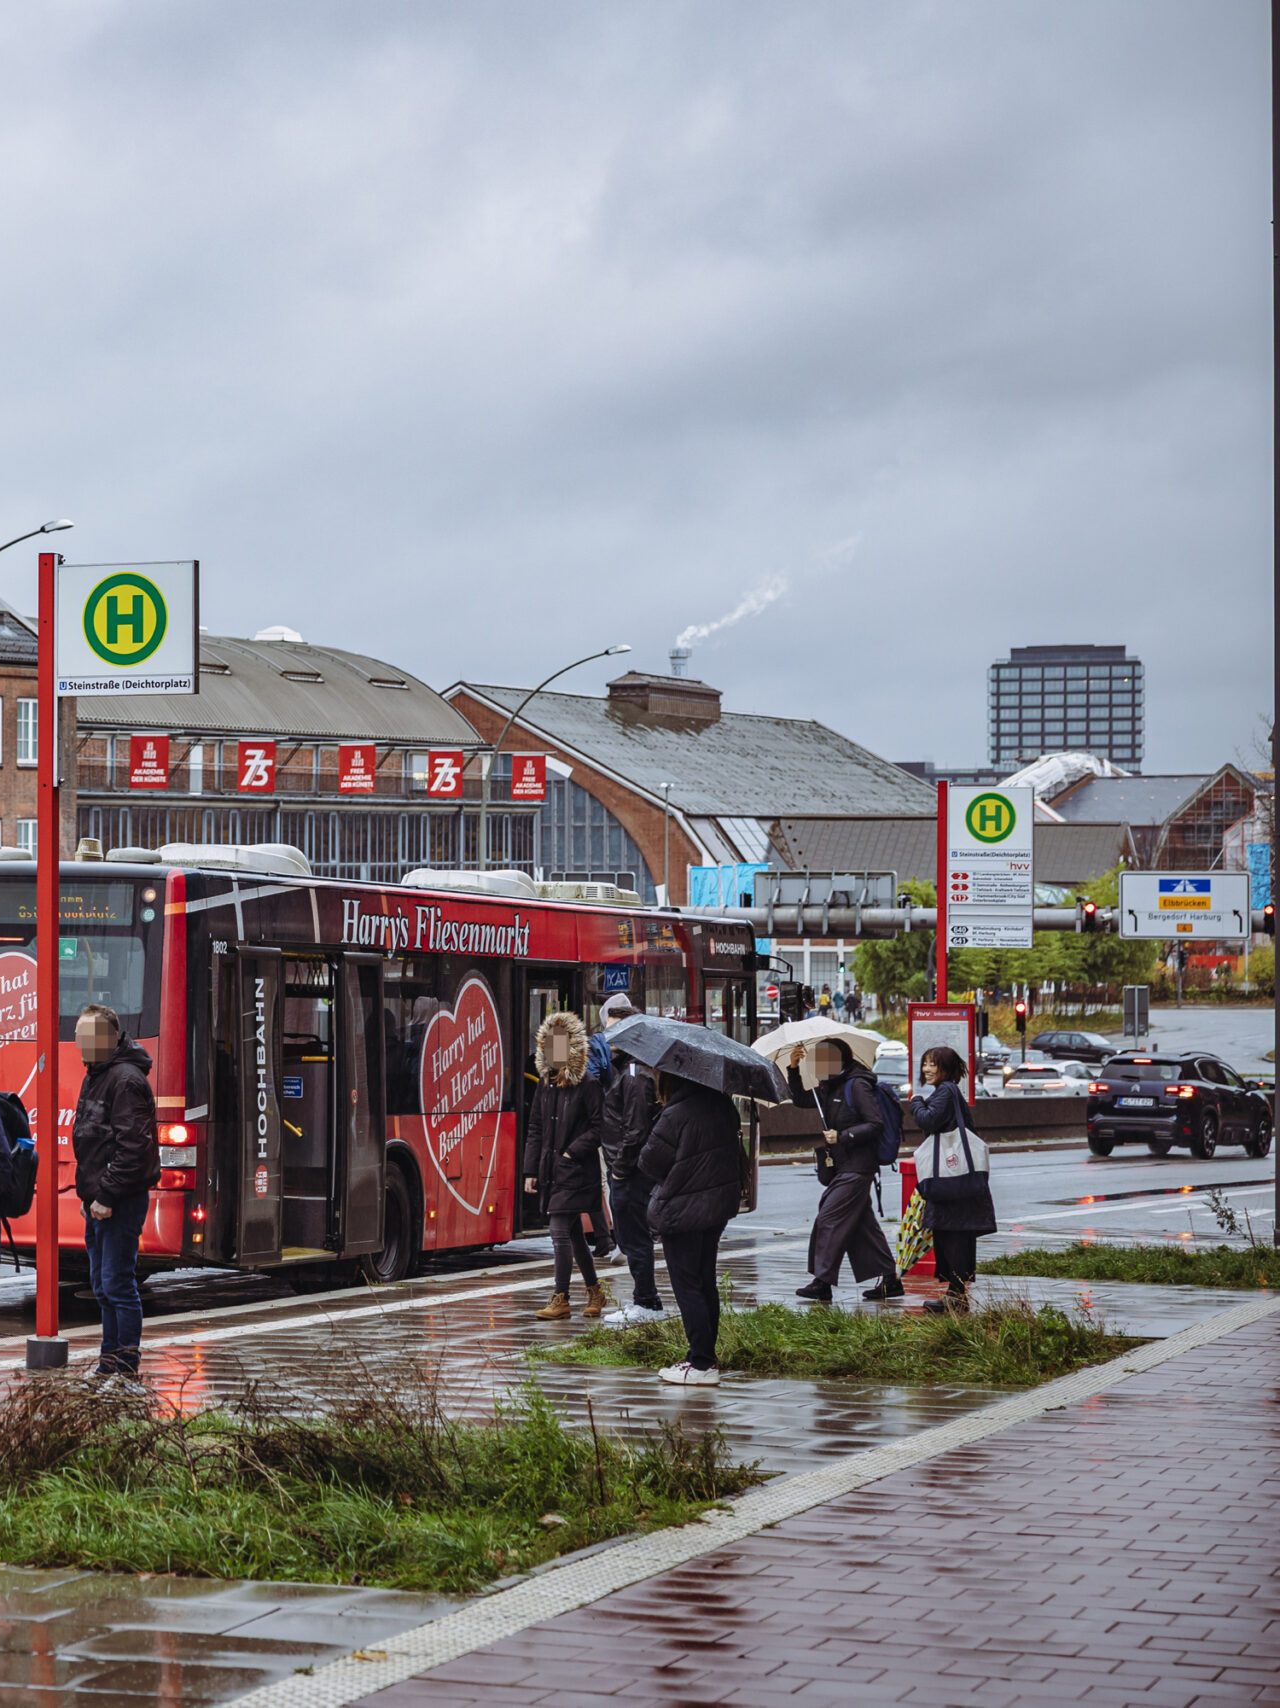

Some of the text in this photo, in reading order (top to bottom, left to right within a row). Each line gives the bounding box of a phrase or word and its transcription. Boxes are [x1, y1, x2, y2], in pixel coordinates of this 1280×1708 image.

[106, 594, 144, 644] H
[68, 680, 120, 690] Steinstraße
[122, 679, 191, 690] (Deichtorplatz)
[134, 768, 165, 776] AKADEMIE
[144, 775, 166, 783] KÜNSTE
[353, 780, 374, 788] KÜNSTE
[524, 787, 544, 795] KÜNSTE
[979, 804, 1002, 832] H
[1009, 862, 1030, 870] hvv
[1163, 898, 1207, 907] Elbbrücken
[1148, 913, 1222, 922] Bergedorf Harburg
[413, 905, 530, 957] Fliesenmarkt
[212, 941, 227, 954] 1802
[715, 942, 746, 955] HOCHBAHN
[0, 969, 29, 995] hat
[17, 993, 37, 1021] fü
[431, 1006, 486, 1083] Harry hat
[255, 977, 268, 1159] HOCHBAHN
[431, 1040, 498, 1129] ein Herz für
[438, 1074, 500, 1163] Bauherren!
